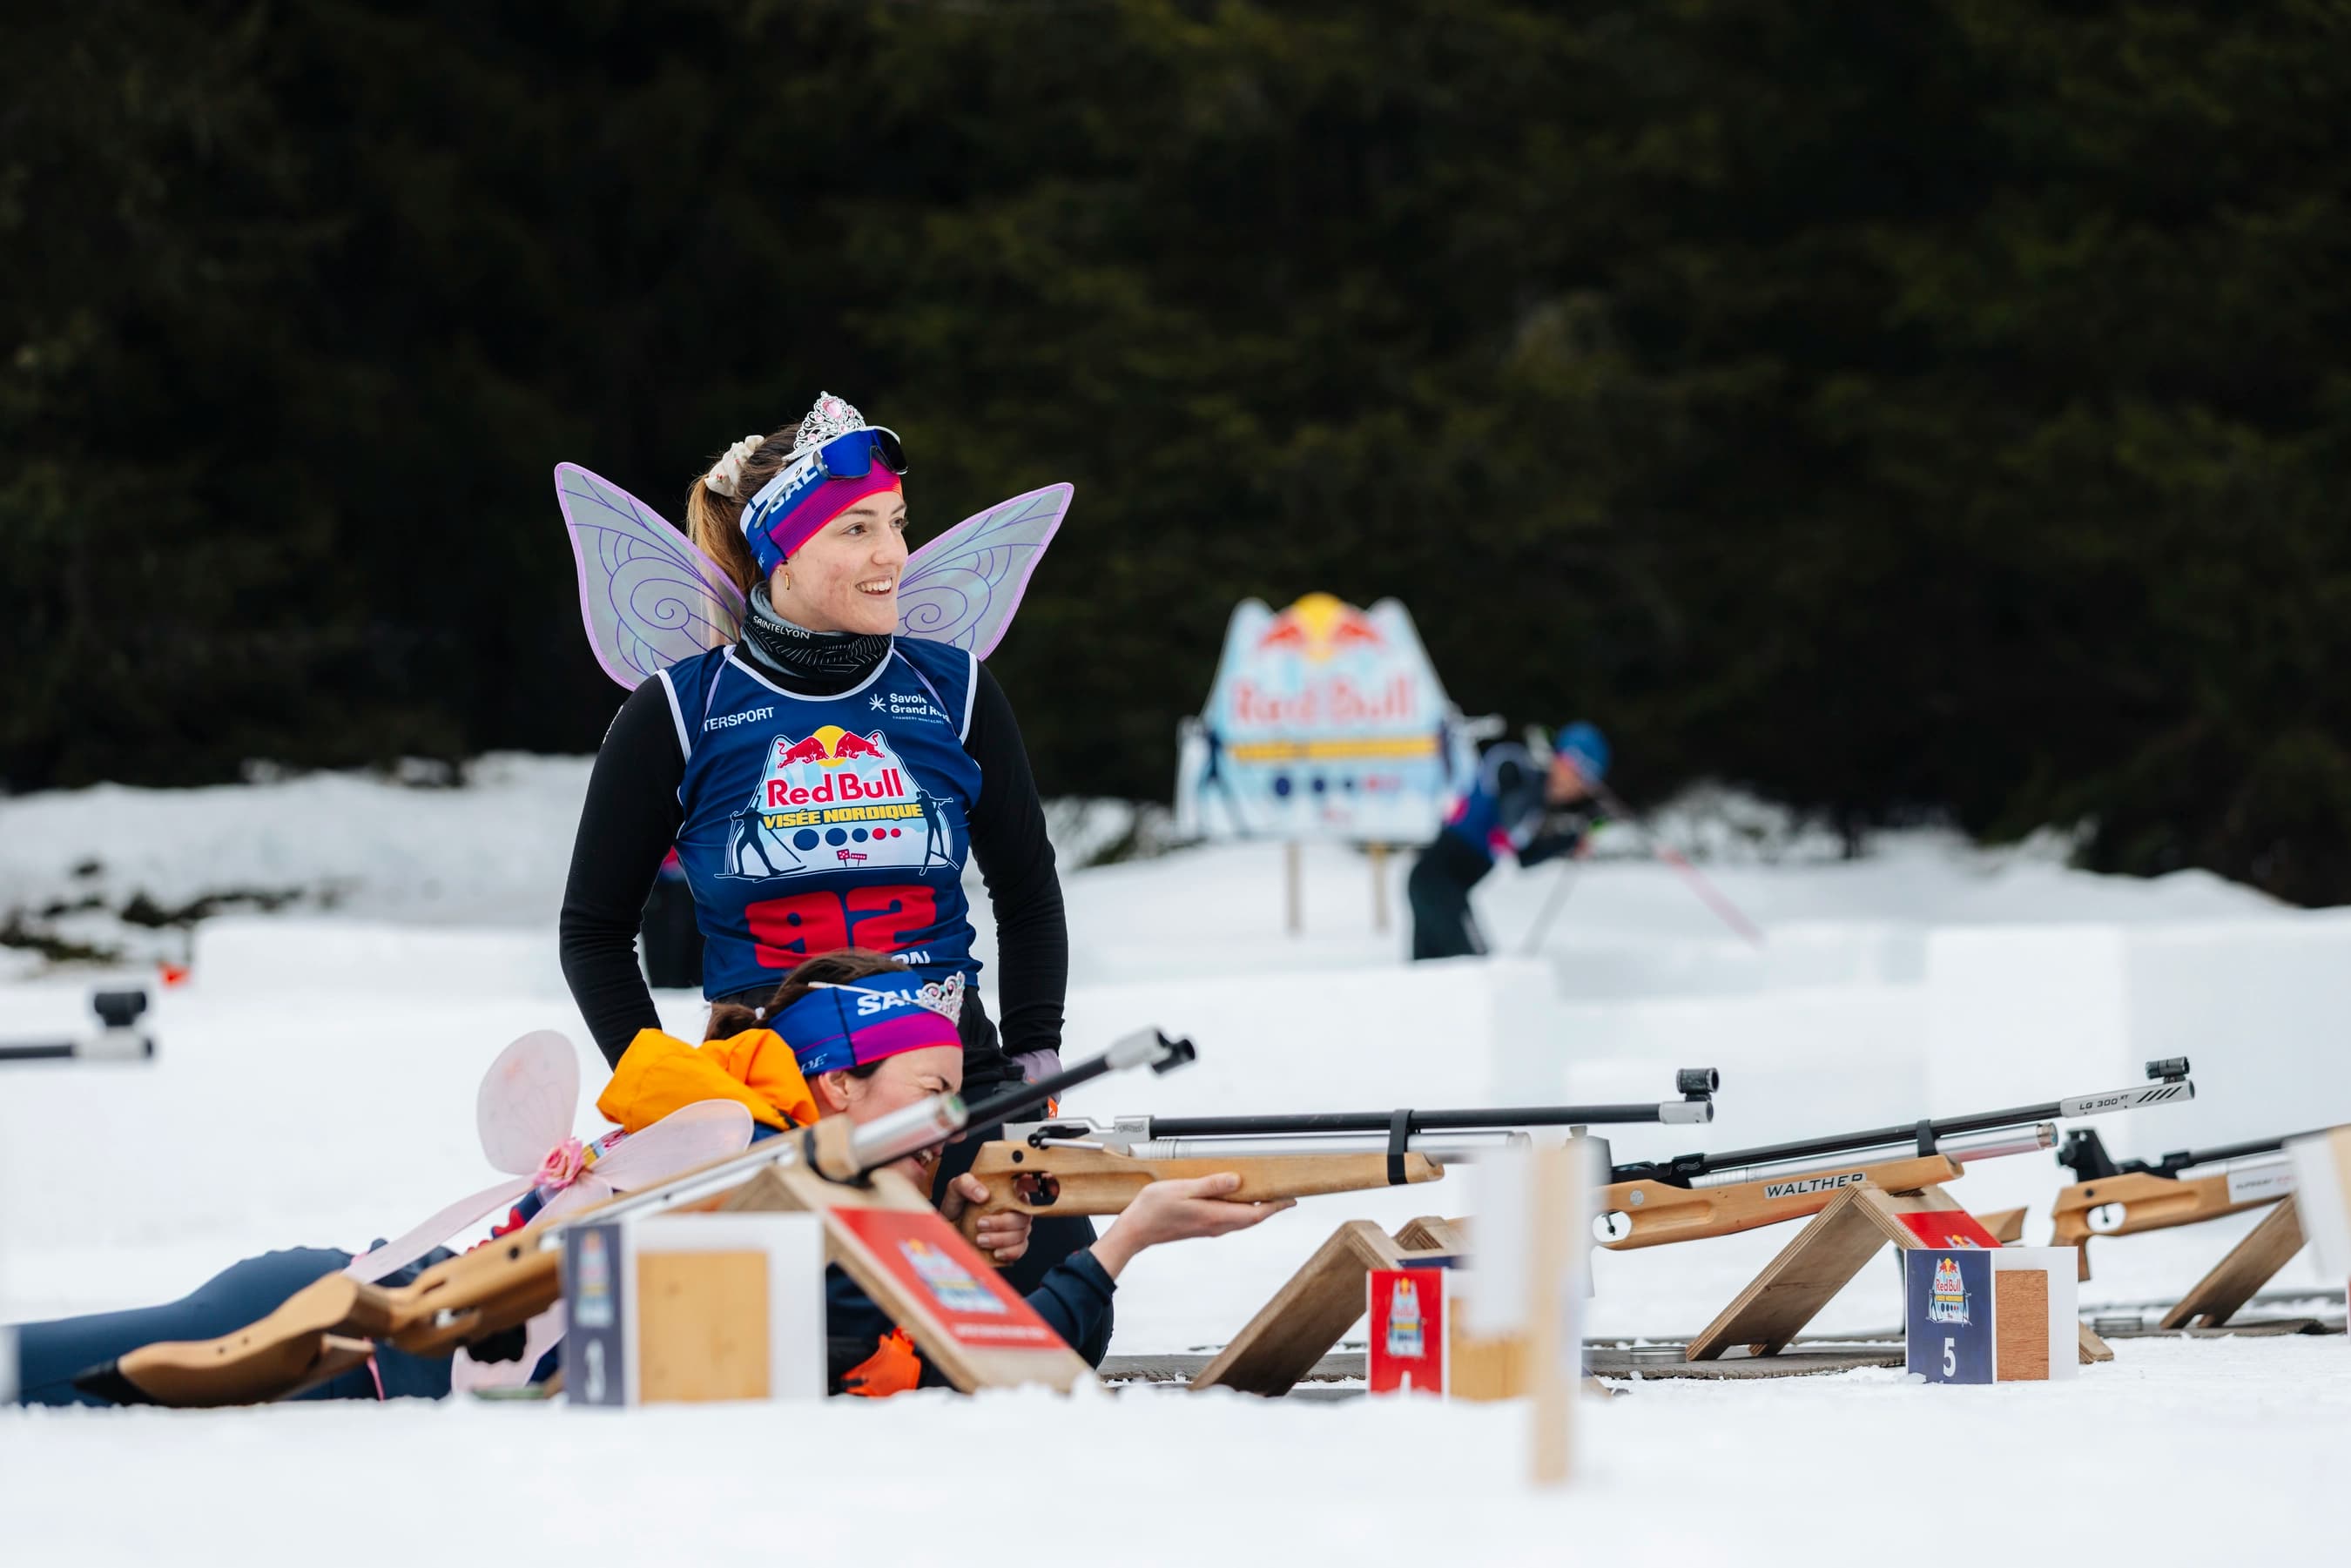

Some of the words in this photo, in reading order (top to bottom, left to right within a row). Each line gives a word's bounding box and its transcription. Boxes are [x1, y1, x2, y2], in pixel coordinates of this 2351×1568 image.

[752, 615, 811, 640] SAINTELYON
[890, 704, 927, 716] Grand
[766, 773, 834, 808] Red
[838, 768, 905, 801] Bull
[763, 809, 821, 830] VISÉE
[823, 803, 924, 823] NORDIQUE
[744, 884, 937, 968] 92
[2097, 1098, 2119, 1108] 300
[1936, 1278, 1949, 1291] Red
[1949, 1278, 1961, 1292] Bull
[1943, 1337, 1957, 1377] 5
